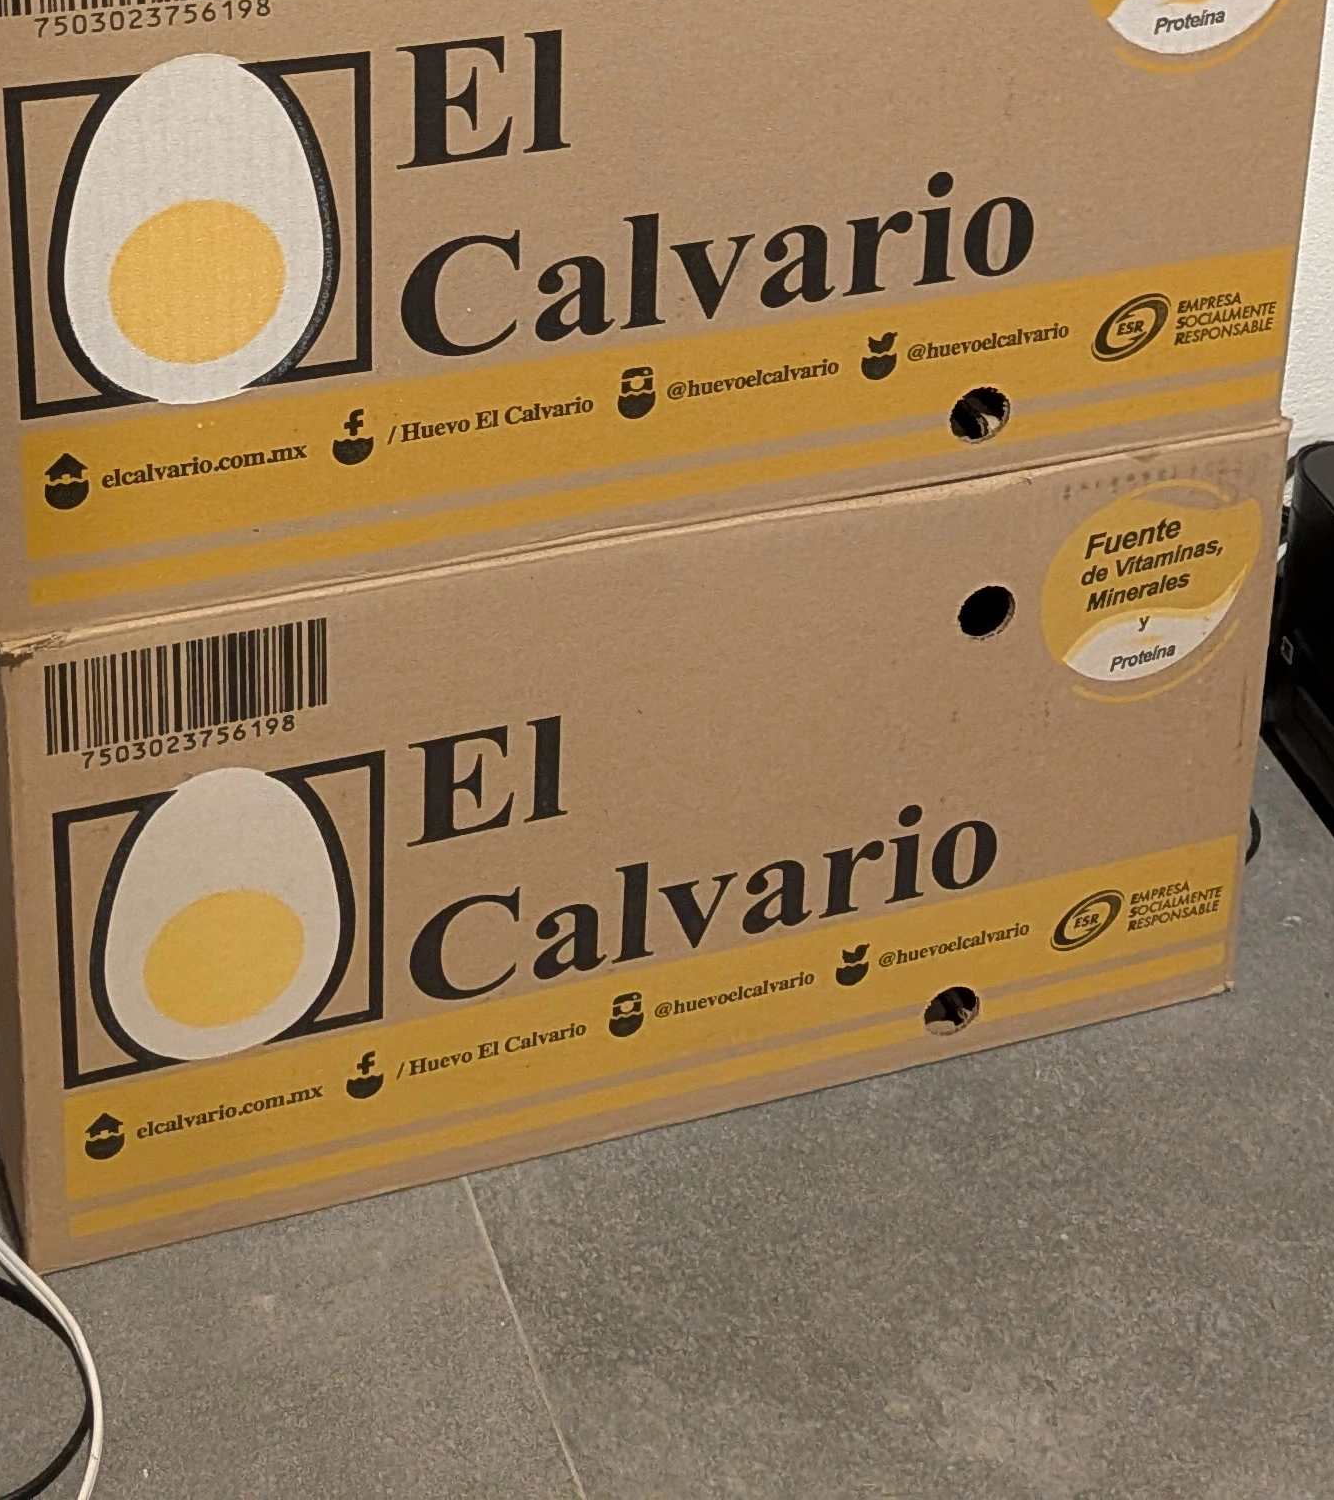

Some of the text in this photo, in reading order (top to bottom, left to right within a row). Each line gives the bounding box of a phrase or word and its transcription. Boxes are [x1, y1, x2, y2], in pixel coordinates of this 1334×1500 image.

[396, 29, 570, 169] El
[399, 171, 1035, 357] Calvario
[1176, 292, 1242, 314] EMPRESA
[1176, 300, 1277, 330] SOCIALMENTE
[907, 322, 1070, 362] @huevoelcalvario
[1116, 319, 1144, 336] ESR
[1174, 317, 1273, 346] RESPONSABLE
[667, 357, 839, 401] @huevoelcalvario
[401, 417, 469, 444] Huevo
[475, 410, 500, 431] El
[505, 395, 594, 425] Calvario
[101, 442, 308, 491] elcalvario.com.mx
[1084, 518, 1182, 560] Fuente
[1081, 537, 1224, 586] de Vitaminas,
[1086, 571, 1191, 613] Minerales
[1137, 614, 1150, 632] y
[81, 716, 296, 770] 7503023756198
[407, 715, 568, 847] El
[410, 804, 998, 1002] Calvario
[1128, 885, 1223, 919] SOCIALMENTE
[1129, 880, 1191, 906] EMPRESA
[1073, 913, 1100, 929] ESR
[1127, 901, 1220, 932] RESPONSABLE
[878, 922, 1030, 969] @huevoelcalvario
[653, 971, 815, 1020] @huevoelcalvario
[409, 1051, 472, 1077] Huevo
[478, 1042, 500, 1061] El
[504, 1022, 588, 1055] Calvario
[136, 1083, 323, 1141] elcalvario.com.mx
